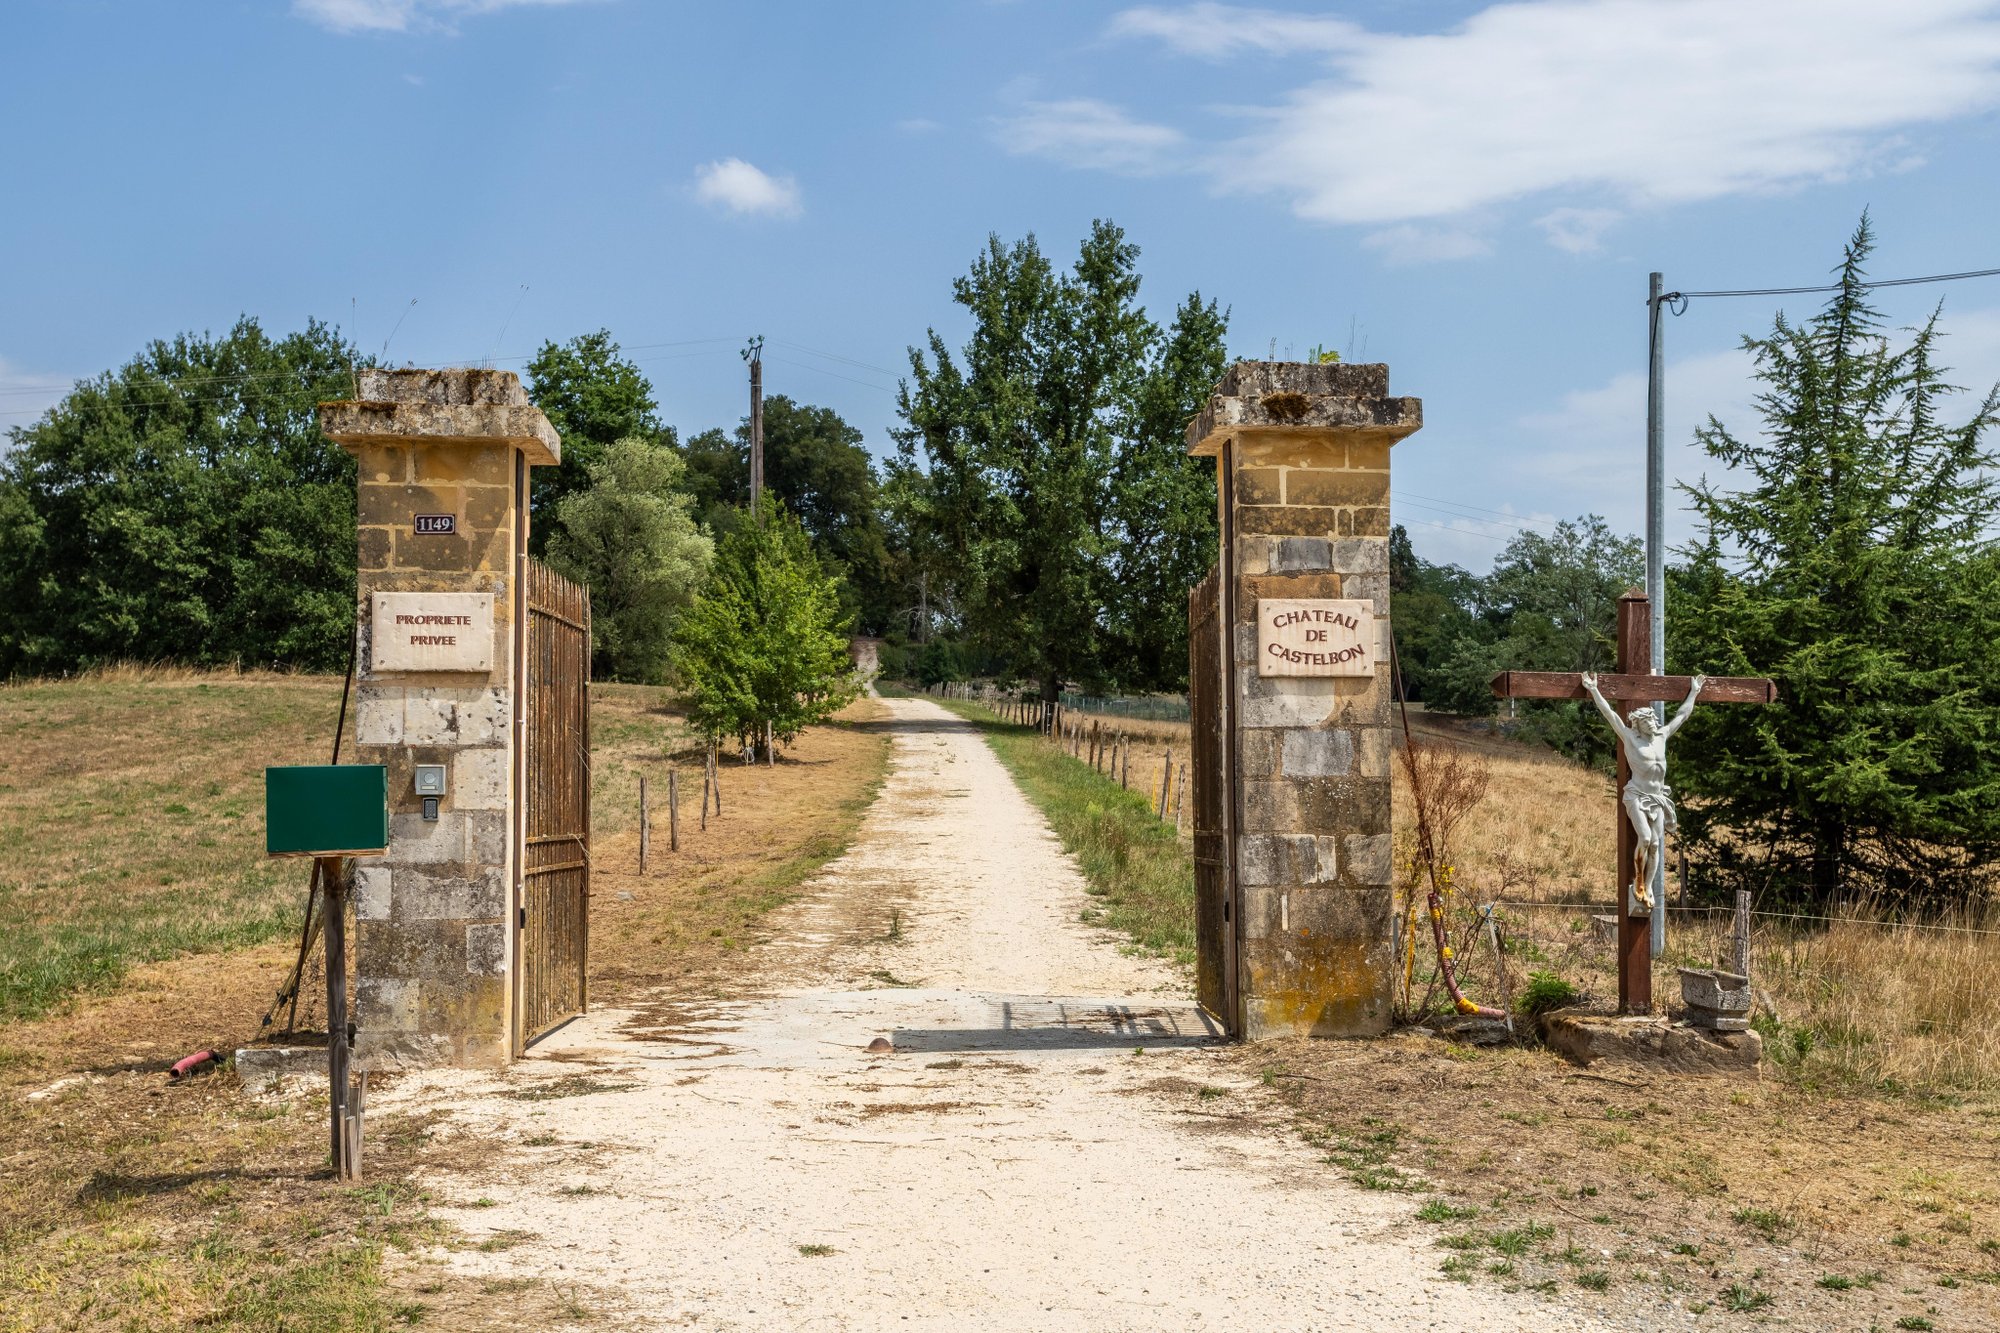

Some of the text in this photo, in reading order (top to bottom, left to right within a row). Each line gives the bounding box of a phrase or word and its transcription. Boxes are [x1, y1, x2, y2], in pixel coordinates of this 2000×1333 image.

[419, 518, 451, 531] 1149
[395, 614, 472, 626] PROPRIETE
[1272, 609, 1359, 631] CHATEAU
[410, 635, 456, 646] PRIVEE
[1305, 629, 1328, 642] DE
[1267, 642, 1366, 666] CASTELBON
